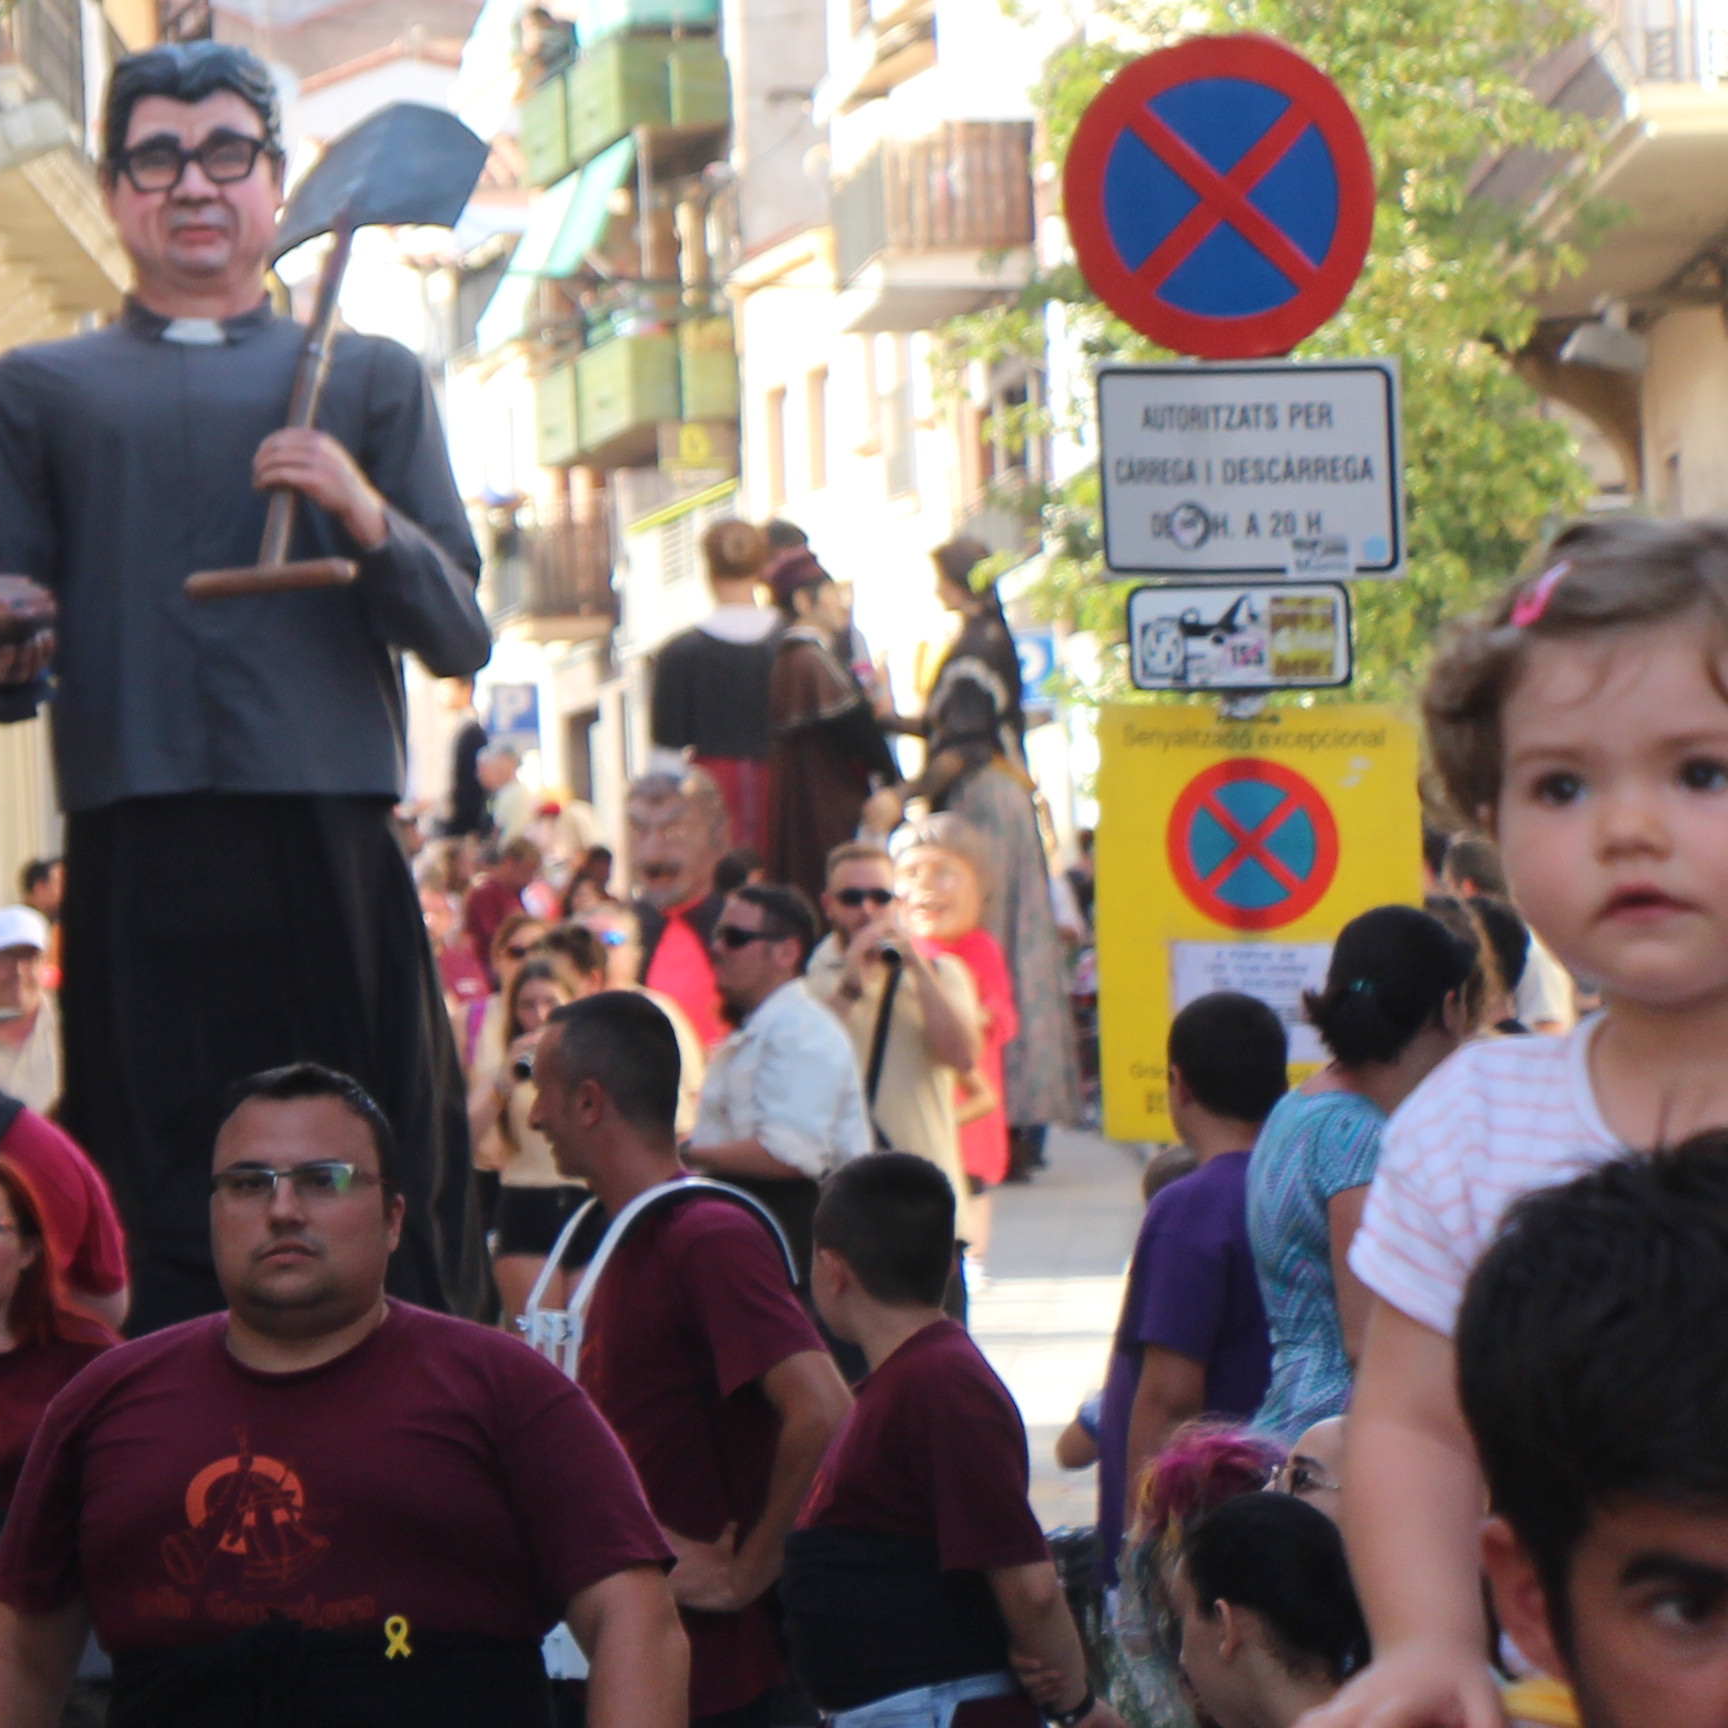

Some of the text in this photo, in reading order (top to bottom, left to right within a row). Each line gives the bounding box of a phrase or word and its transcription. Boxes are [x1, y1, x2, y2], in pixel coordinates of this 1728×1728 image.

[1141, 402, 1334, 431] AUTORITZATS PER
[1203, 459, 1213, 486] I
[1221, 450, 1376, 485] DESCÀRREGA
[1245, 512, 1260, 538] A
[1269, 511, 1297, 538] 20
[1307, 510, 1323, 535] H
[495, 685, 532, 732] P
[1258, 725, 1387, 753] excepcional
